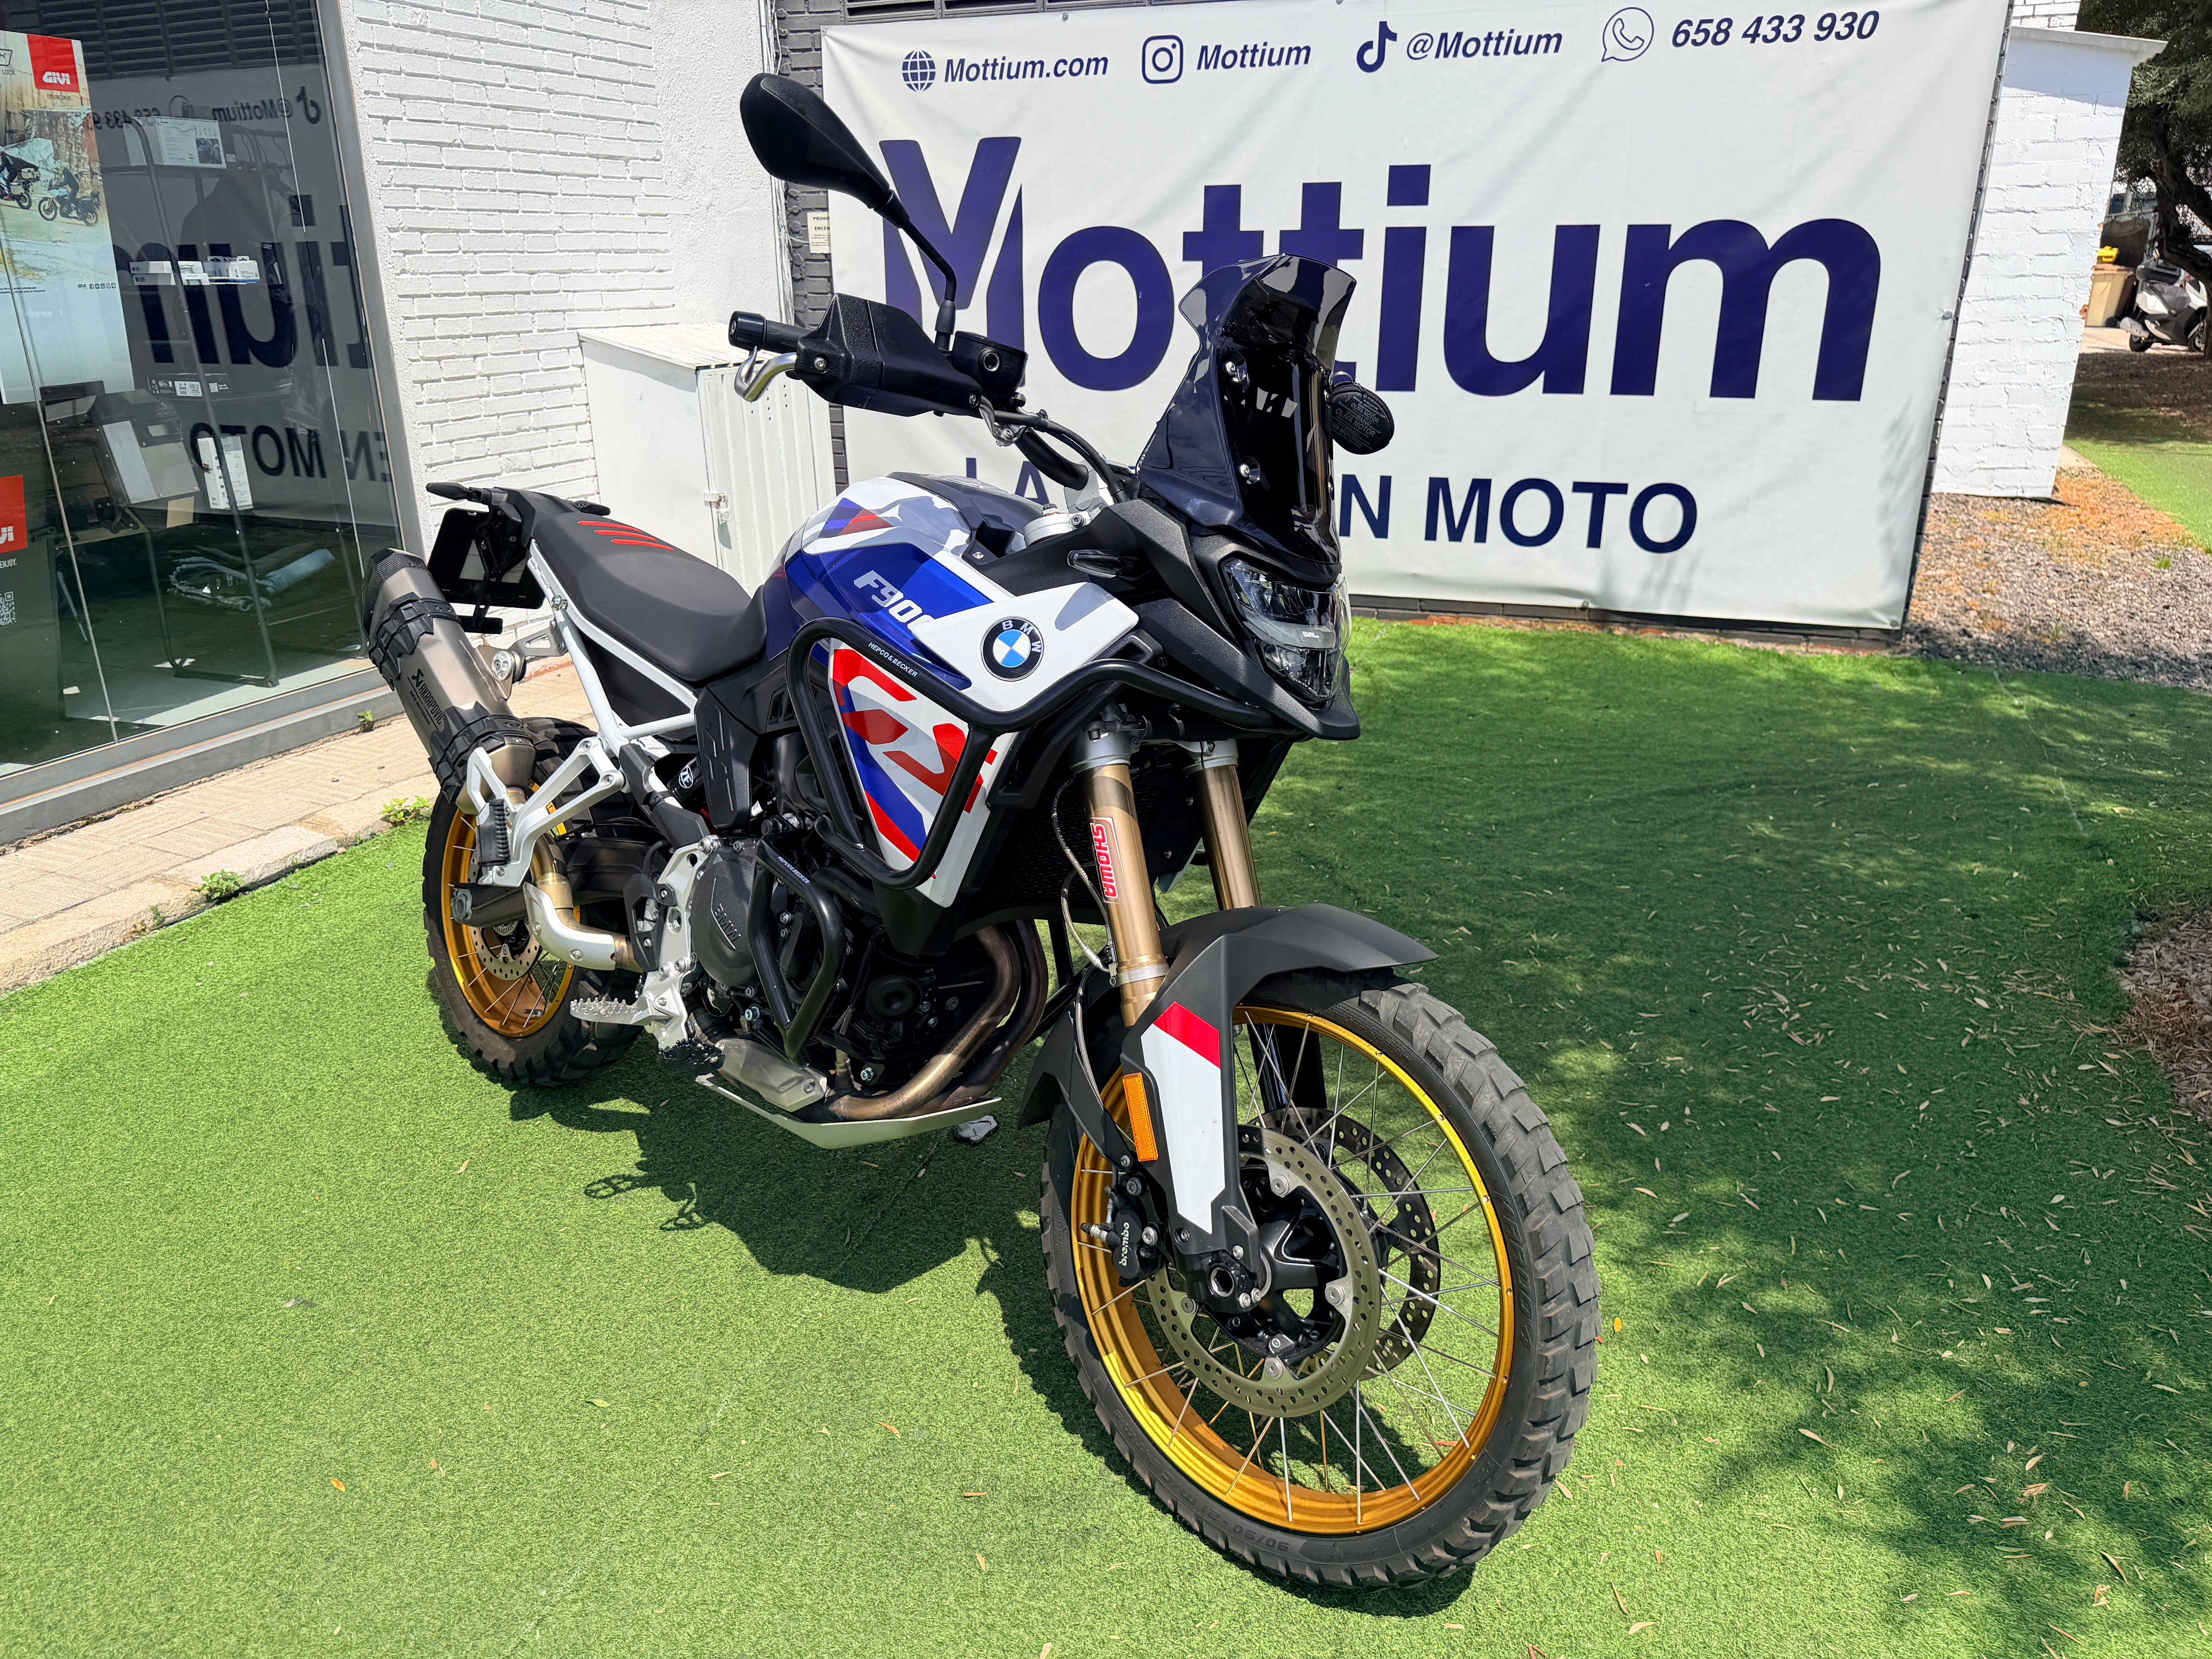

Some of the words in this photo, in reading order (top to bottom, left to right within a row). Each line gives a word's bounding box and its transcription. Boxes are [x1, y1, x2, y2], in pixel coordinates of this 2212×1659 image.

[1407, 29, 1562, 60] @Mottium
[1672, 18, 1733, 48] 658
[1741, 15, 1805, 44] 433
[1814, 11, 1879, 42] 930
[944, 56, 1108, 82] Mottium.com
[1197, 41, 1311, 70] Mottium
[43, 71, 70, 85] GIVI
[1336, 408, 1354, 423] OLIVA
[1353, 420, 1376, 438] MOTOR
[1355, 414, 1371, 426] BMW
[1424, 477, 1698, 554] MOTO
[1001, 620, 1041, 653] BMW
[1090, 823, 1118, 898] SHOWA
[714, 903, 742, 943] BMW
[1119, 1222, 1130, 1267] brembo
